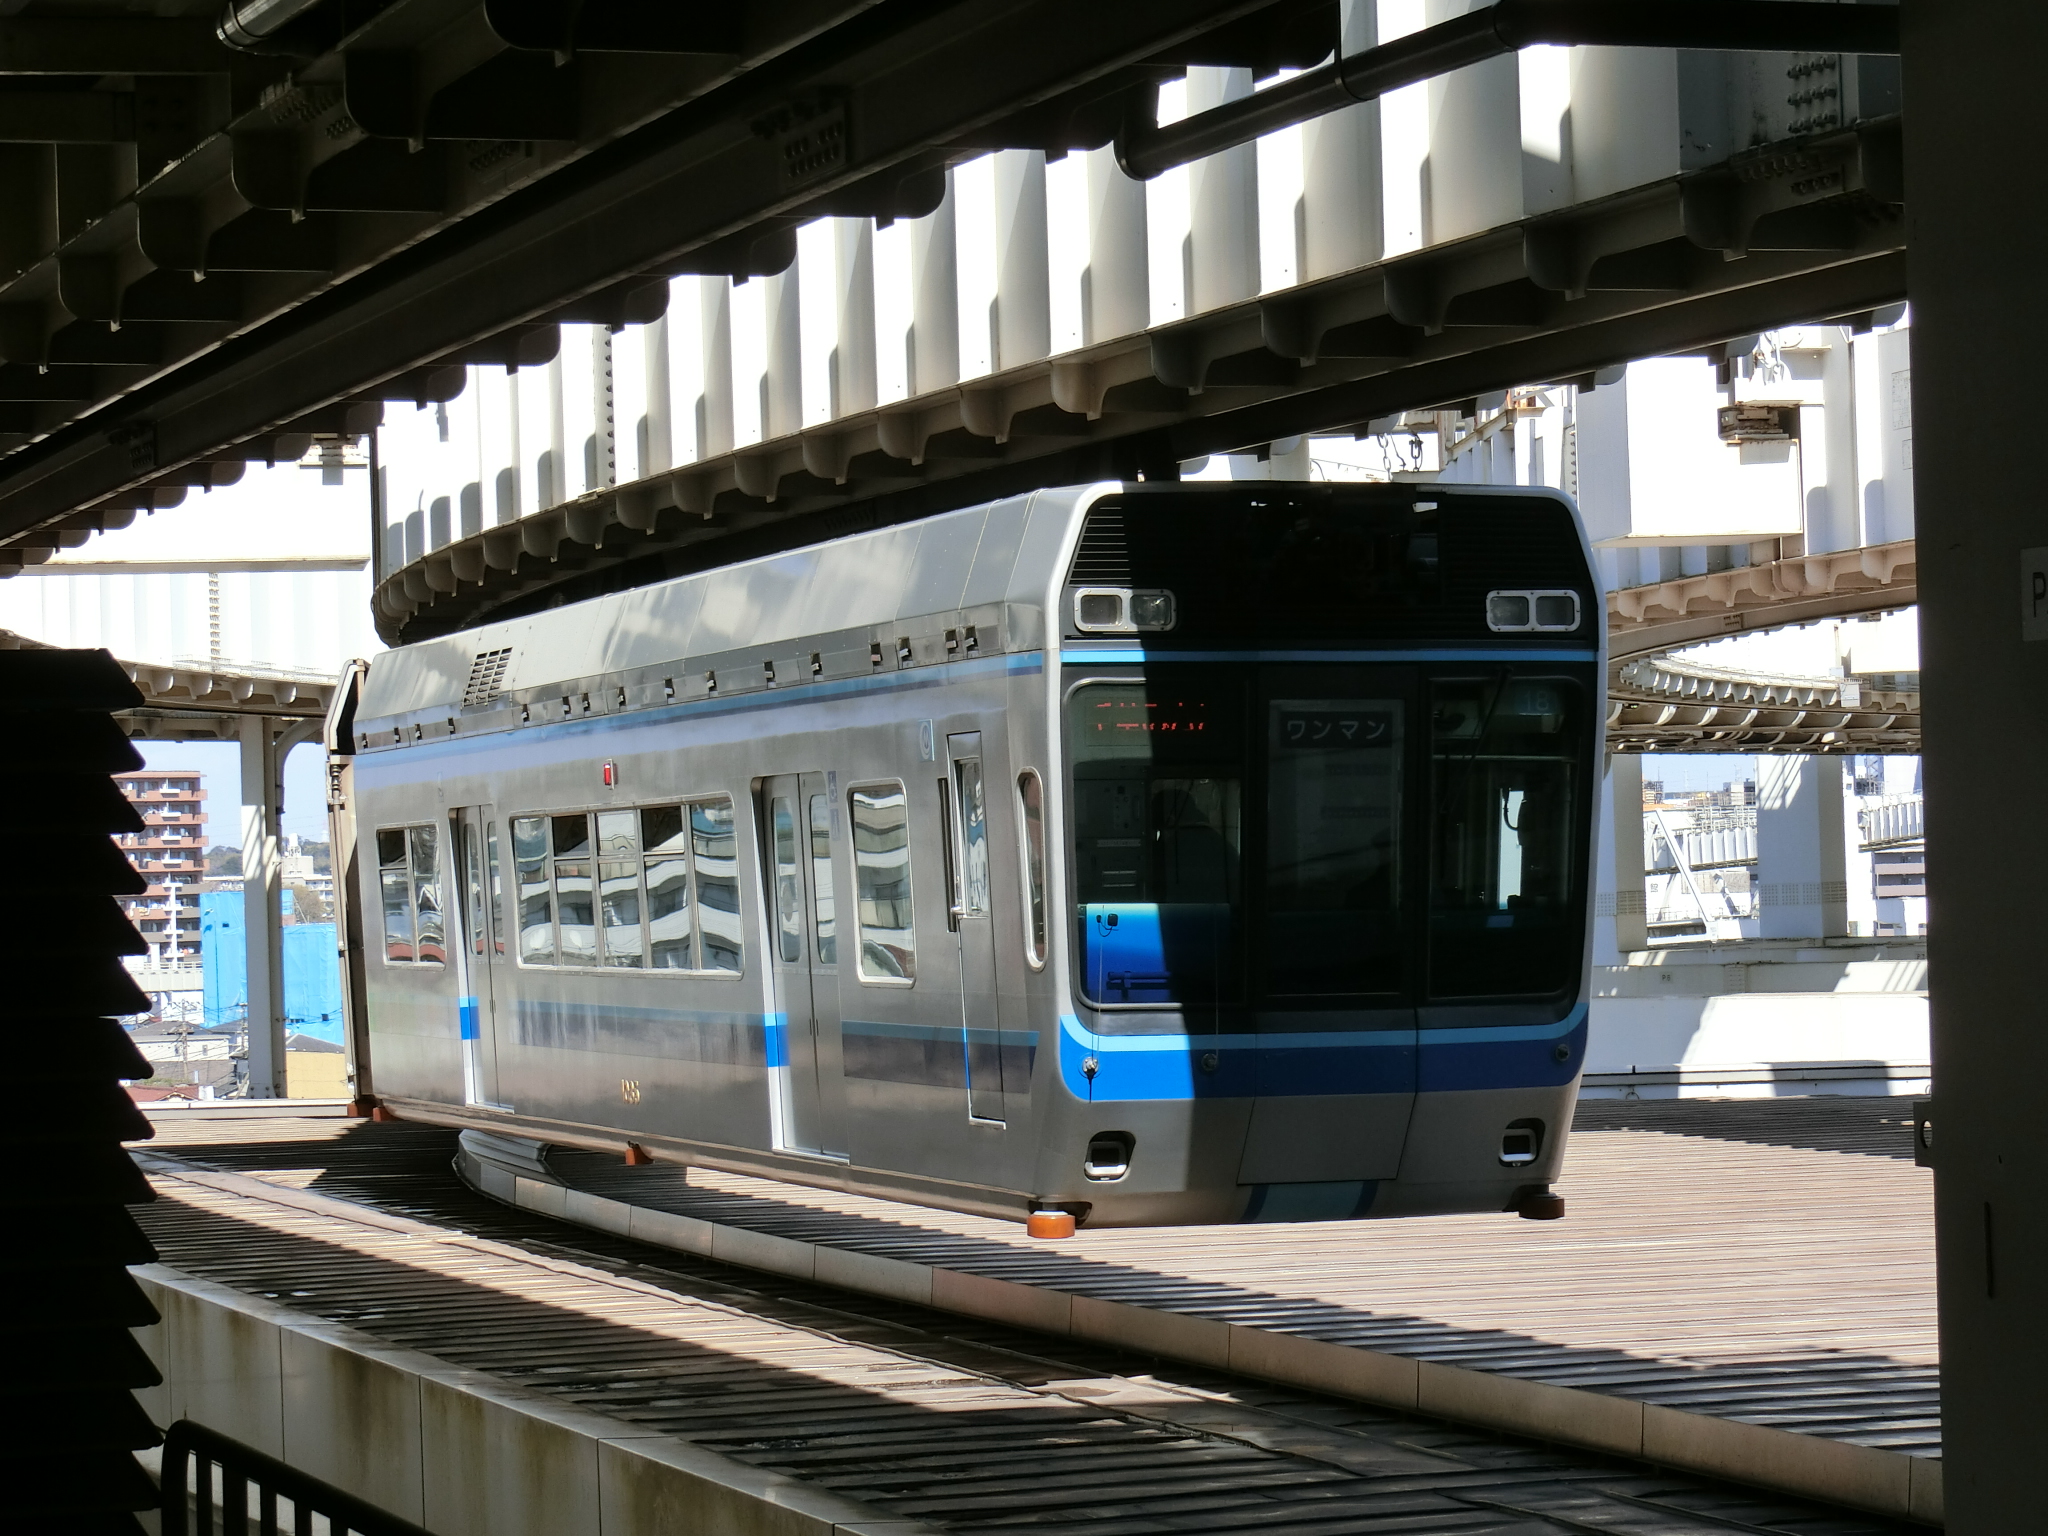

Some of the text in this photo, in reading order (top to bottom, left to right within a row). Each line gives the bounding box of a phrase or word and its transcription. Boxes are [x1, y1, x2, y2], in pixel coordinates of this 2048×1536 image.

[2033, 572, 2048, 617] P
[1287, 719, 1386, 740] ワンマン
